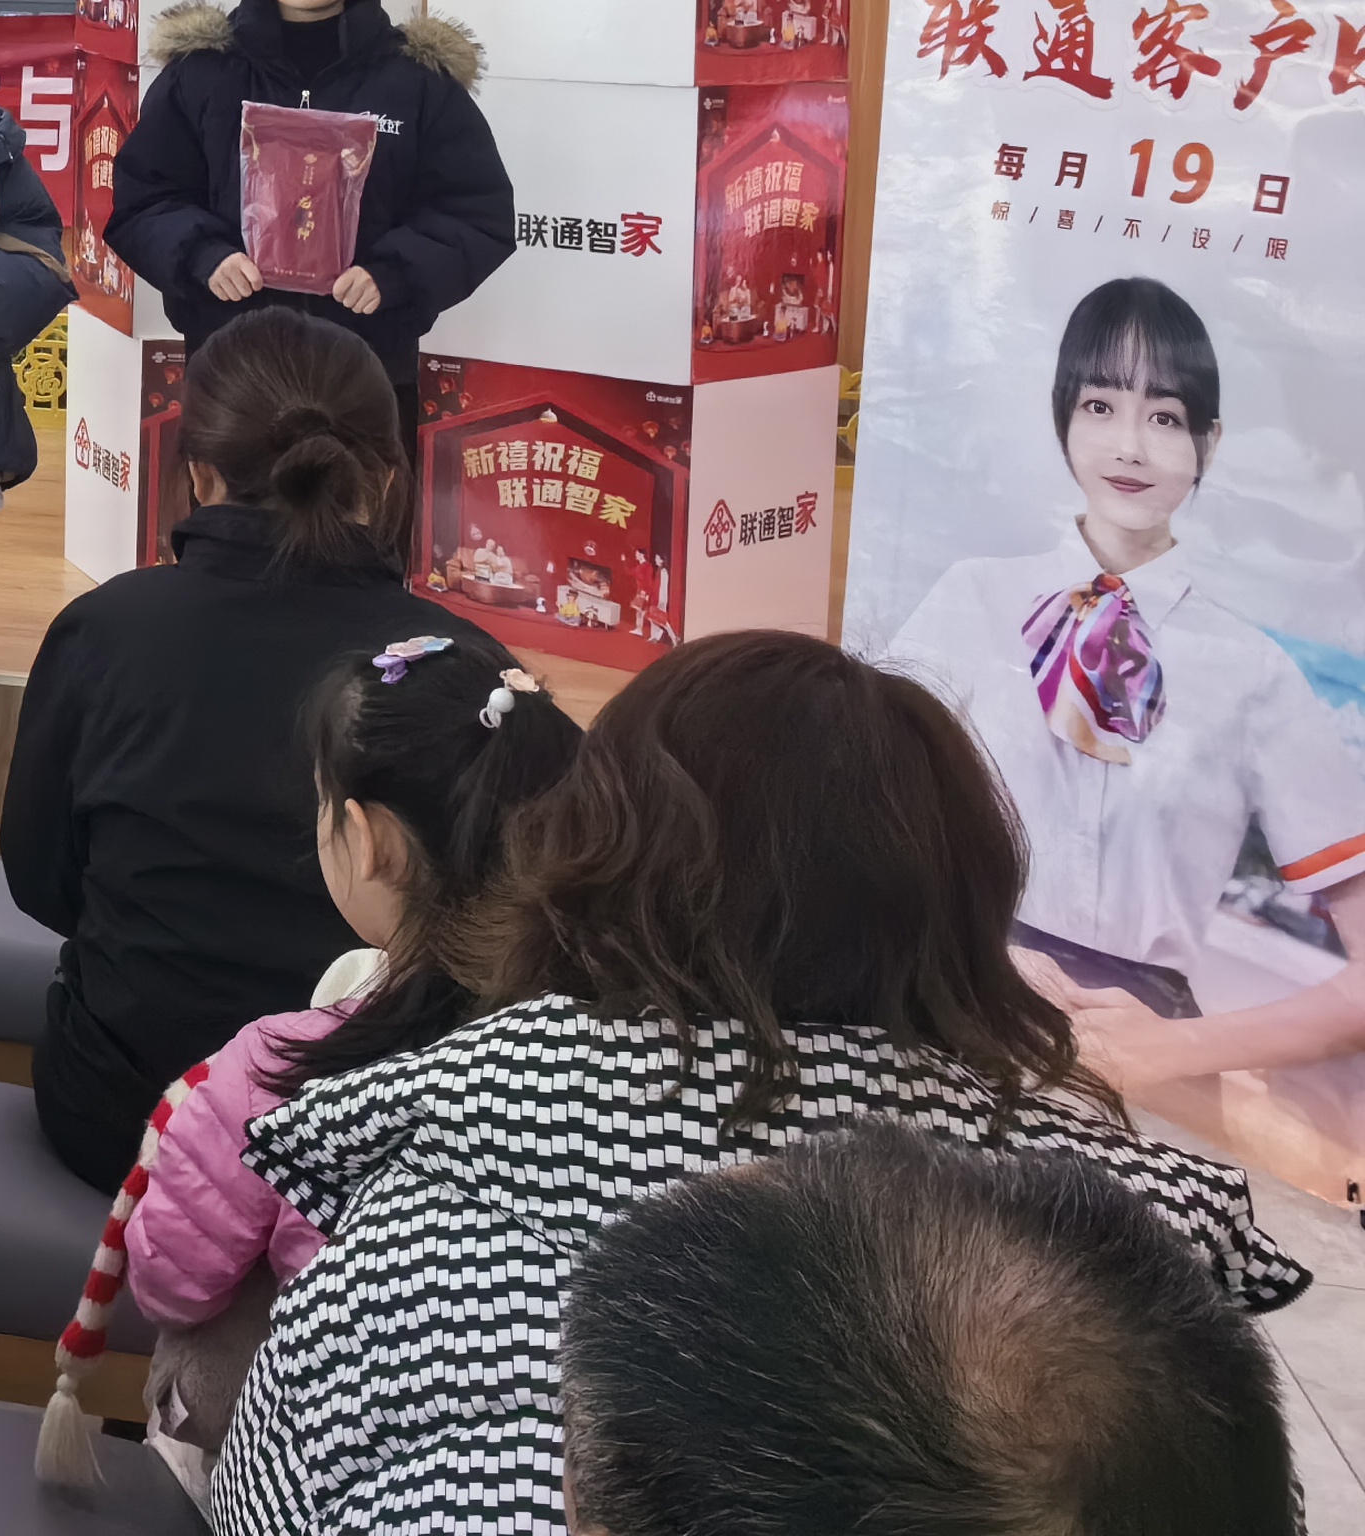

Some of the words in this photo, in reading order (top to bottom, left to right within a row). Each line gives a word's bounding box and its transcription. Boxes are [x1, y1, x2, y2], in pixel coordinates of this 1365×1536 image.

[724, 161, 804, 214] 新禧祝福
[516, 211, 663, 257] 联通智家
[743, 197, 820, 239] 联通智家
[91, 440, 132, 493] 联通智家
[461, 439, 605, 482] 新禧祝福
[496, 476, 638, 530] 联通智家
[739, 490, 819, 547] 联通智家
